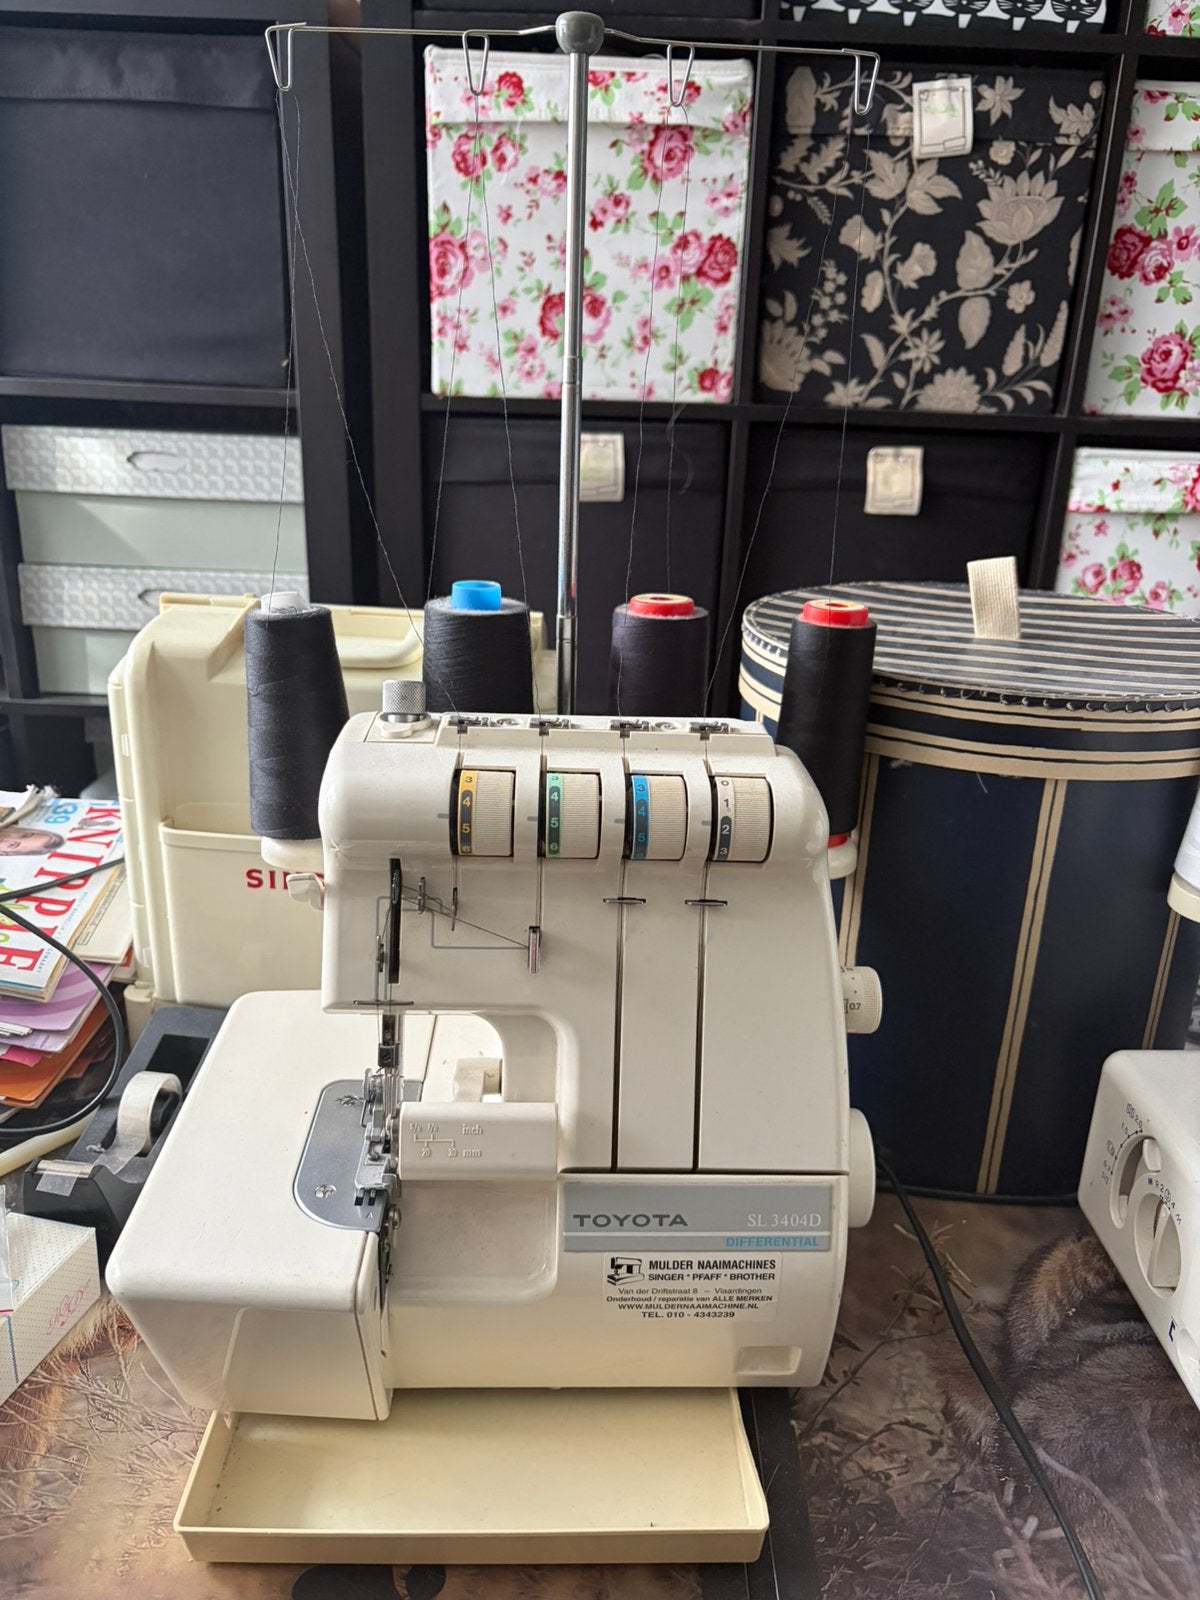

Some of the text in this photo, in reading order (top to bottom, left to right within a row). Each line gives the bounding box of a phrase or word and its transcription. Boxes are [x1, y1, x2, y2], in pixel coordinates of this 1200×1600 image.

[462, 1123, 484, 1136] inch
[462, 1149, 483, 1158] mm
[572, 1213, 822, 1228] TOYOTA SL 3404D
[725, 1236, 820, 1248] DIFFERENTIAL
[648, 1259, 777, 1271] MULDER NAAIMACHINES
[648, 1272, 776, 1281] SINGER PFAFF BROTHER
[617, 1287, 634, 1295] Van
[635, 1287, 650, 1295] der
[651, 1287, 692, 1295] Driftstraat
[714, 1287, 762, 1296] Vlaardingen
[657, 1295, 695, 1303] reparatie
